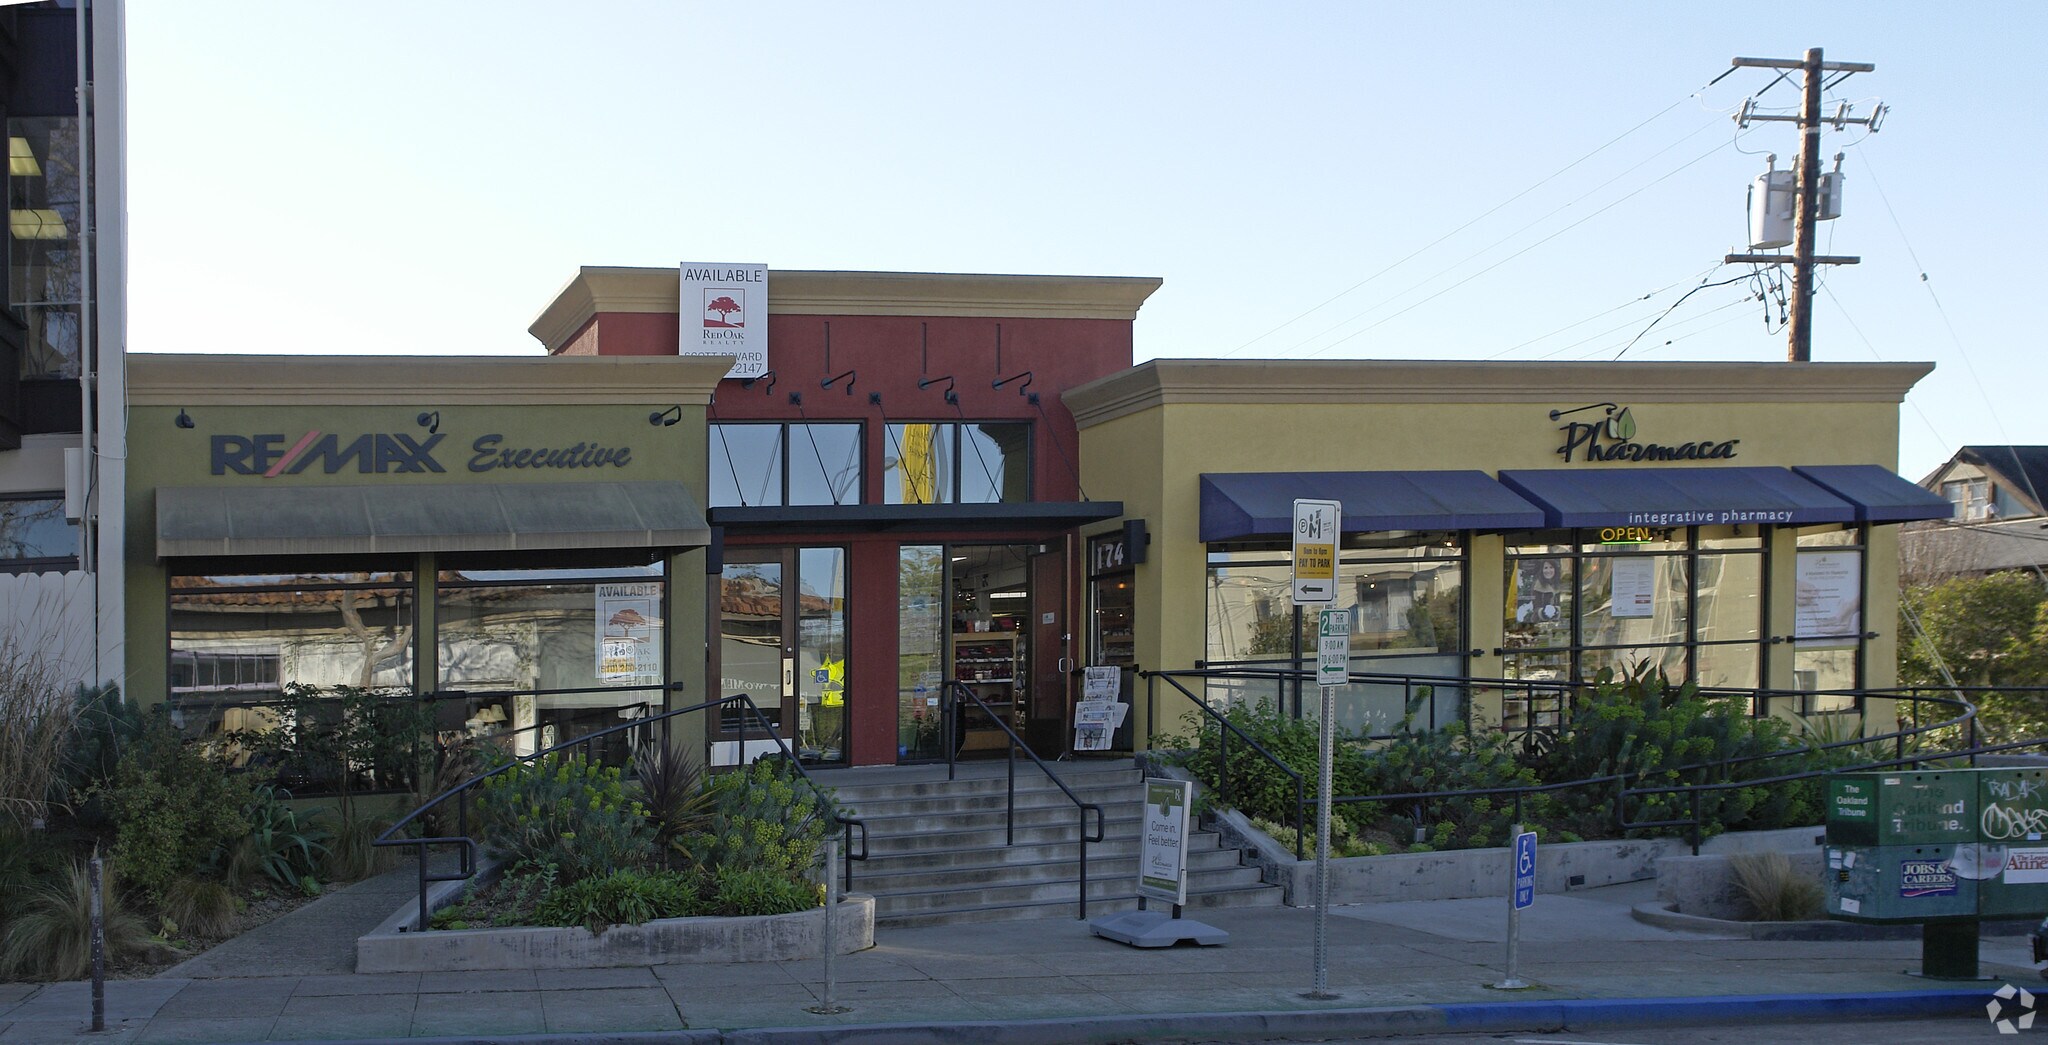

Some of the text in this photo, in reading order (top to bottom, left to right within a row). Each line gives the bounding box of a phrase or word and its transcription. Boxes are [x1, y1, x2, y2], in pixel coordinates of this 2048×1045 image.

[684, 268, 763, 282] AVAILABLE
[703, 329, 744, 340] RED OAK
[721, 352, 763, 361] VARD
[1556, 421, 1741, 463] Pharmaca
[211, 430, 633, 478] RE/MAX Executive
[1629, 509, 1794, 525] integrative pharmacy
[1601, 527, 1650, 541] OPEN
[1298, 558, 1331, 568] PAY TO PARK
[599, 585, 657, 597] AVAILABLE
[1321, 614, 1344, 634] 2 HR
[1330, 624, 1349, 633] PARKING
[1337, 640, 1344, 650] AM
[1321, 654, 1327, 664] TO
[1339, 654, 1347, 664] PM
[1845, 784, 1860, 793] The
[1836, 796, 1868, 805] Oakland
[1838, 808, 1867, 817] Tribune
[1151, 820, 1169, 832] Come
[1149, 833, 1179, 849] Feel better.
[1904, 863, 1947, 875] JOBS &
[1903, 874, 1953, 884] CAREERS
